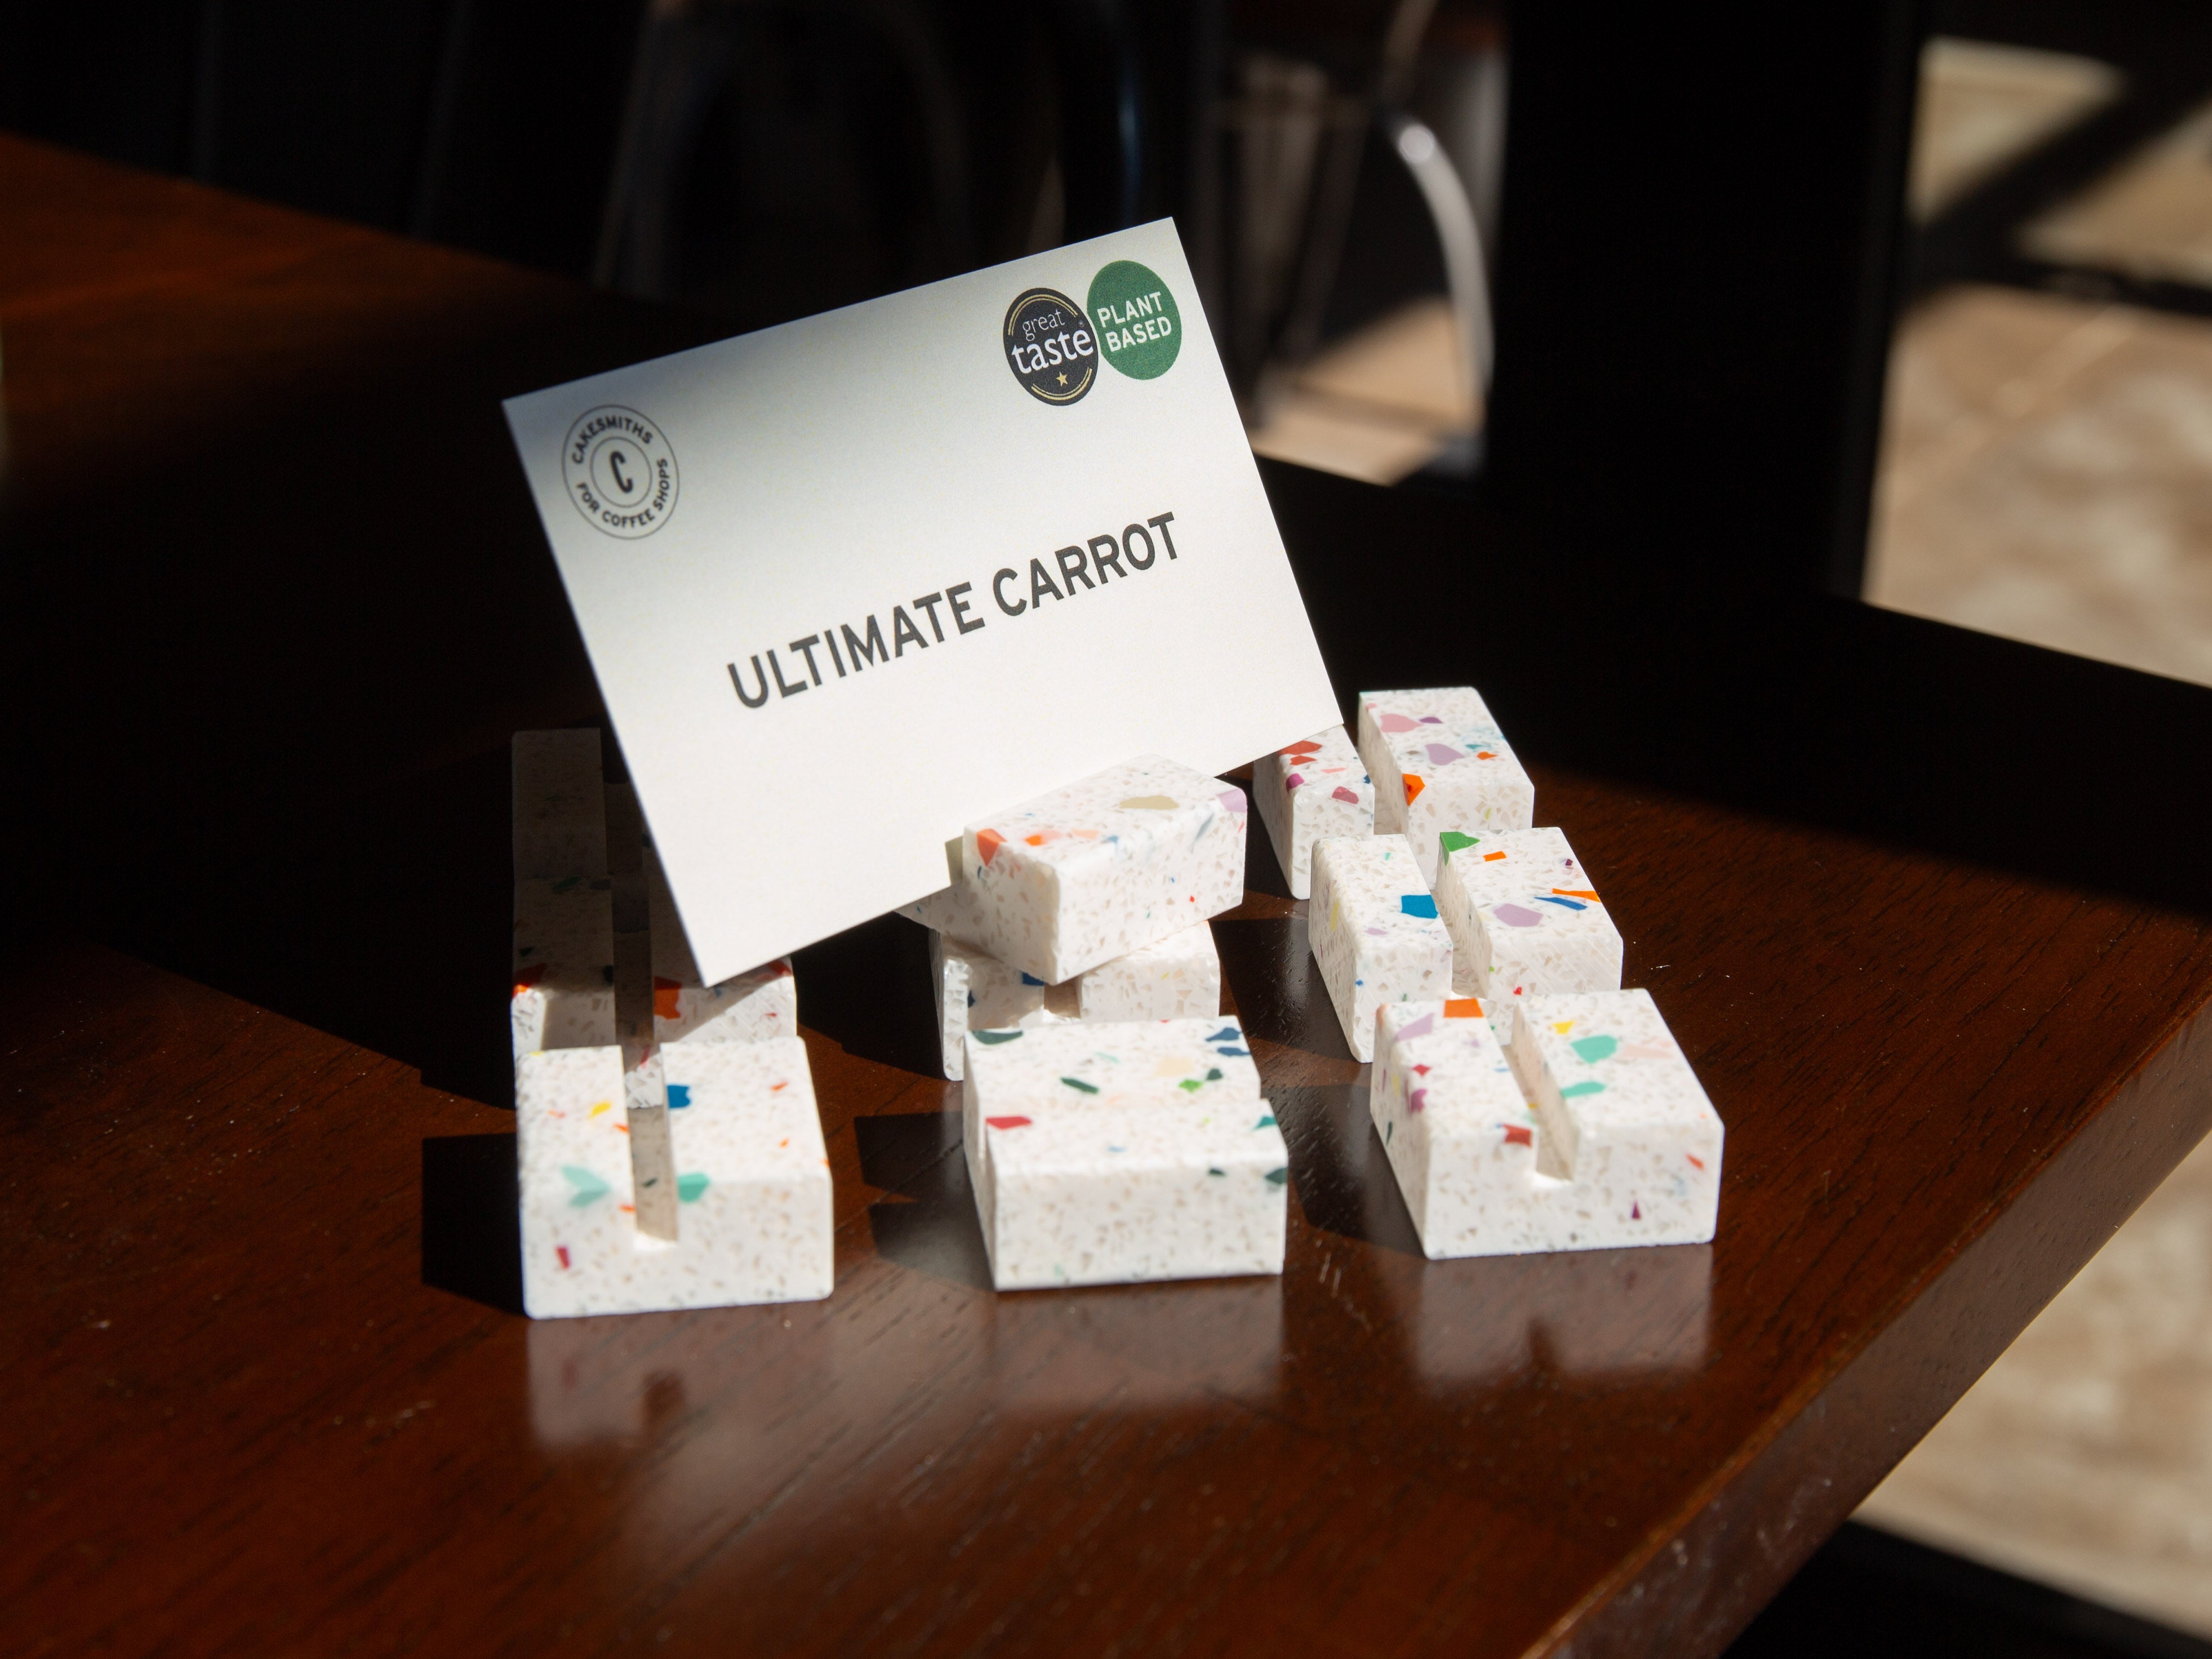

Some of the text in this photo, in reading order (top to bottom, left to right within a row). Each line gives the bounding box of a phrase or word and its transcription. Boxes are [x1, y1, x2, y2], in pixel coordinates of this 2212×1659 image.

[1022, 308, 1065, 341] great
[1097, 292, 1162, 328] PLANT
[1011, 328, 1094, 374] taste
[1105, 316, 1172, 352] BASED
[572, 416, 653, 464] CAKESMITHS
[575, 458, 670, 528] FOR COFFEE SHOPS
[609, 450, 633, 493] C
[727, 511, 1178, 709] ULTIMATE CARROT
